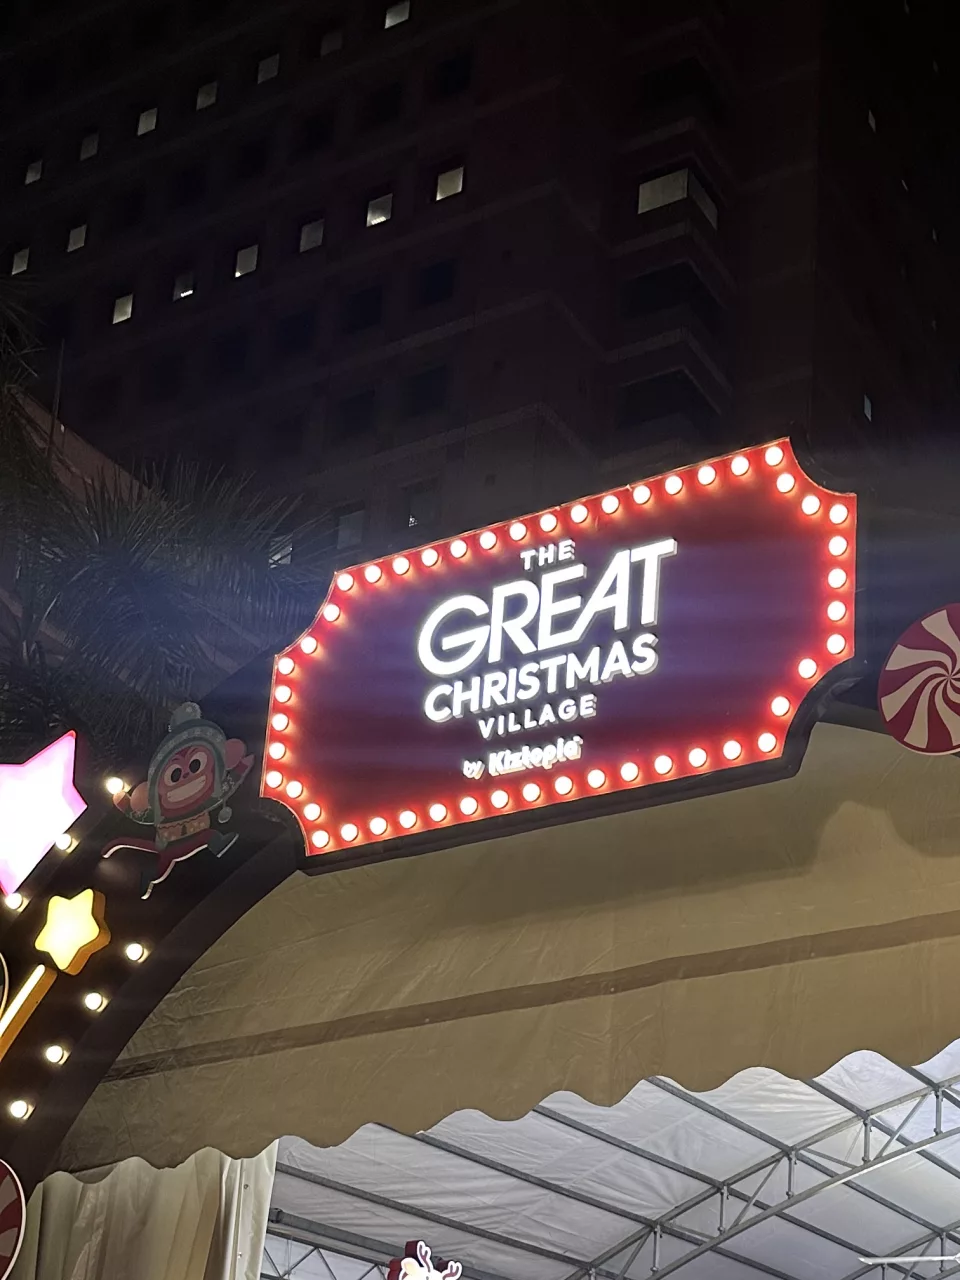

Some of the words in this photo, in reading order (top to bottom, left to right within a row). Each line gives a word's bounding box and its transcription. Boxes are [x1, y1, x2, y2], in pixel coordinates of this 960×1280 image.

[520, 539, 575, 570] THE
[418, 538, 677, 675] GREAT
[424, 633, 658, 722] CHRISTMAS
[478, 693, 597, 738] VILLAGE
[463, 760, 485, 779] by
[488, 735, 583, 776] Kiztopia
